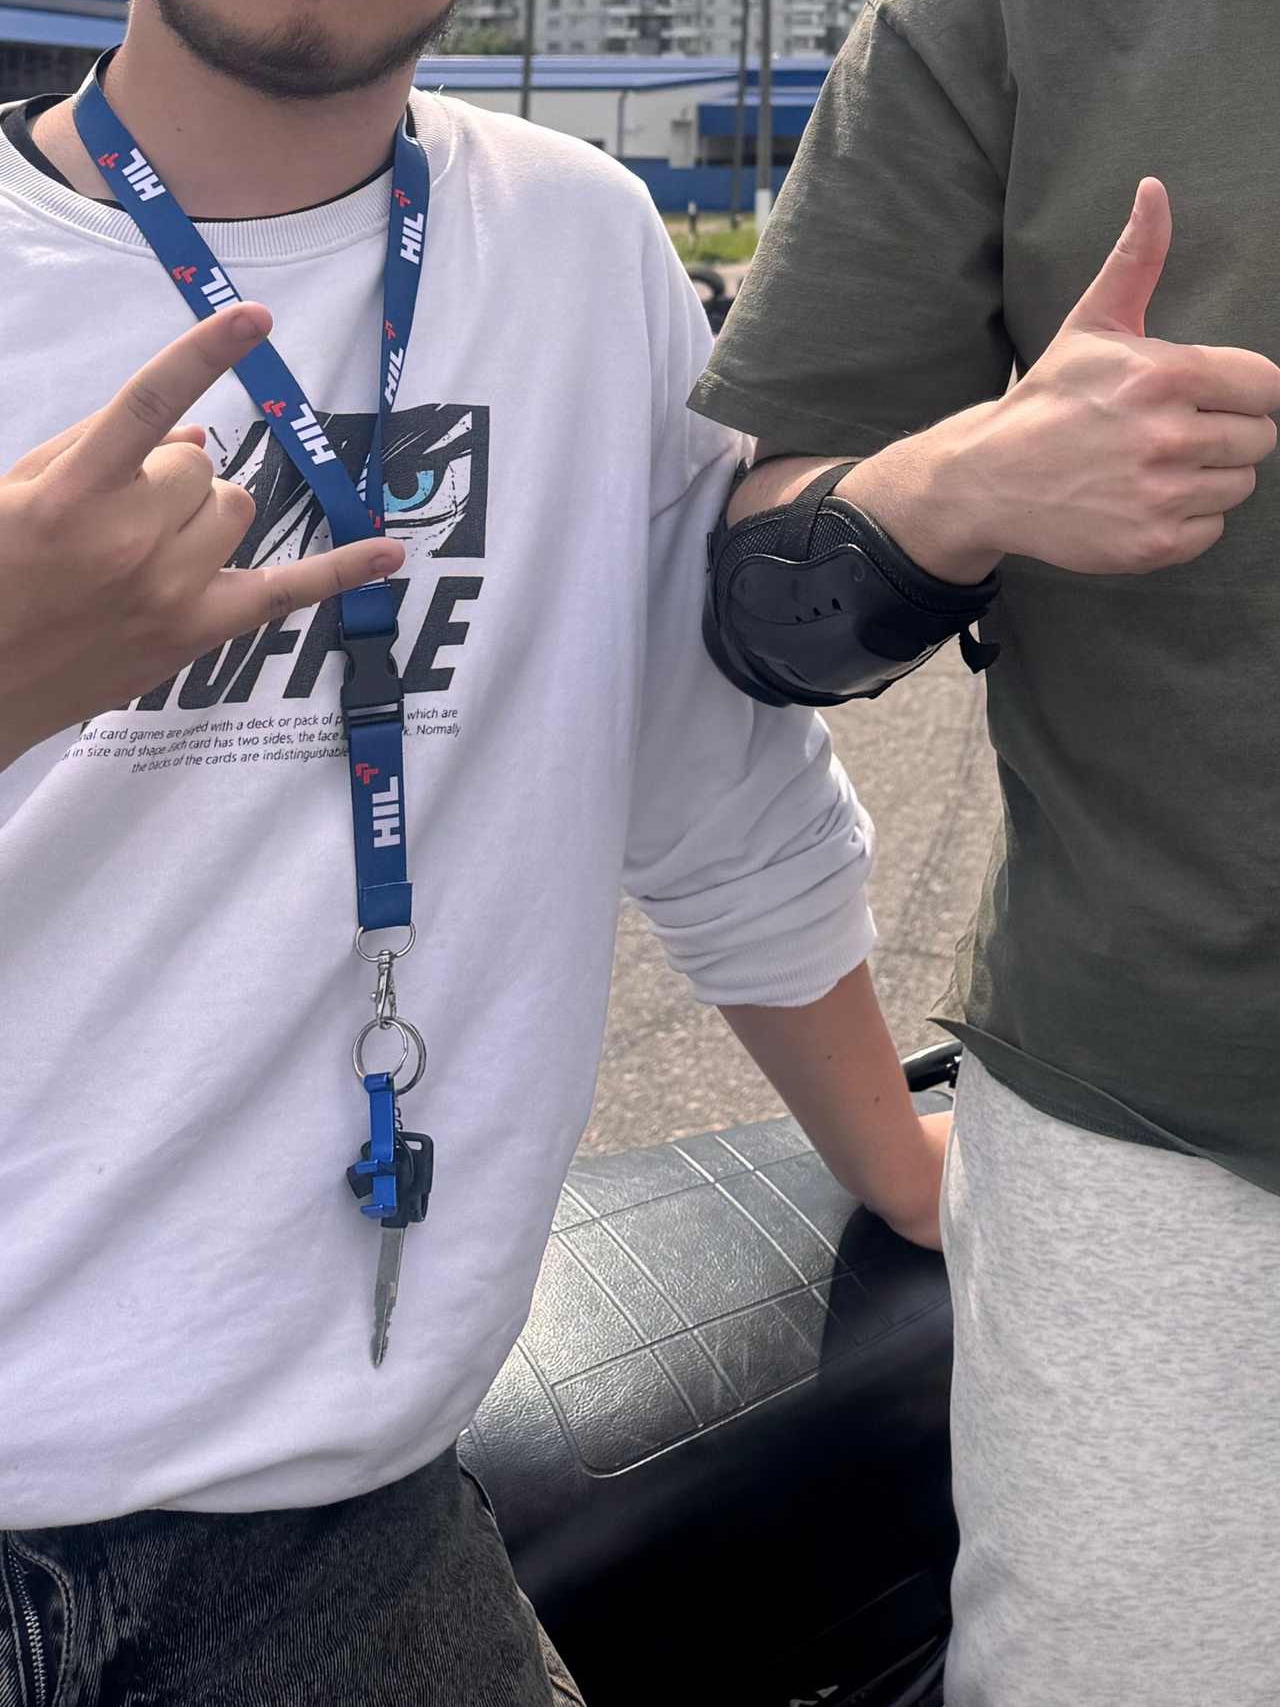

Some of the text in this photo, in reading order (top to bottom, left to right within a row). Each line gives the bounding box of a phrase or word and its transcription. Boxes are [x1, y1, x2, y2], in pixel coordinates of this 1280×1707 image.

[121, 148, 166, 202] HIL
[400, 212, 424, 265] HIL
[384, 347, 404, 406] HIL
[290, 403, 337, 465] HIL
[72, 746, 84, 757] in
[87, 744, 110, 758] size
[113, 744, 137, 758] and
[188, 736, 212, 750] card
[213, 736, 234, 749] has
[237, 734, 260, 747] two
[262, 732, 295, 745] sides,
[298, 730, 316, 743] the
[317, 729, 339, 742] face
[416, 723, 462, 738] Normally
[100, 727, 128, 741] card
[130, 729, 164, 744] games
[166, 730, 182, 740] are
[210, 720, 234, 733] with
[236, 722, 244, 731] a
[246, 717, 275, 730] deck
[278, 717, 292, 728] or
[293, 713, 319, 727] pack
[321, 712, 334, 725] of
[407, 708, 439, 720] which
[441, 709, 459, 719] are
[131, 761, 146, 774] the
[172, 755, 184, 768] of
[184, 752, 204, 767] the
[205, 751, 238, 766] cards
[240, 750, 260, 763] are
[372, 776, 401, 848] HIL
